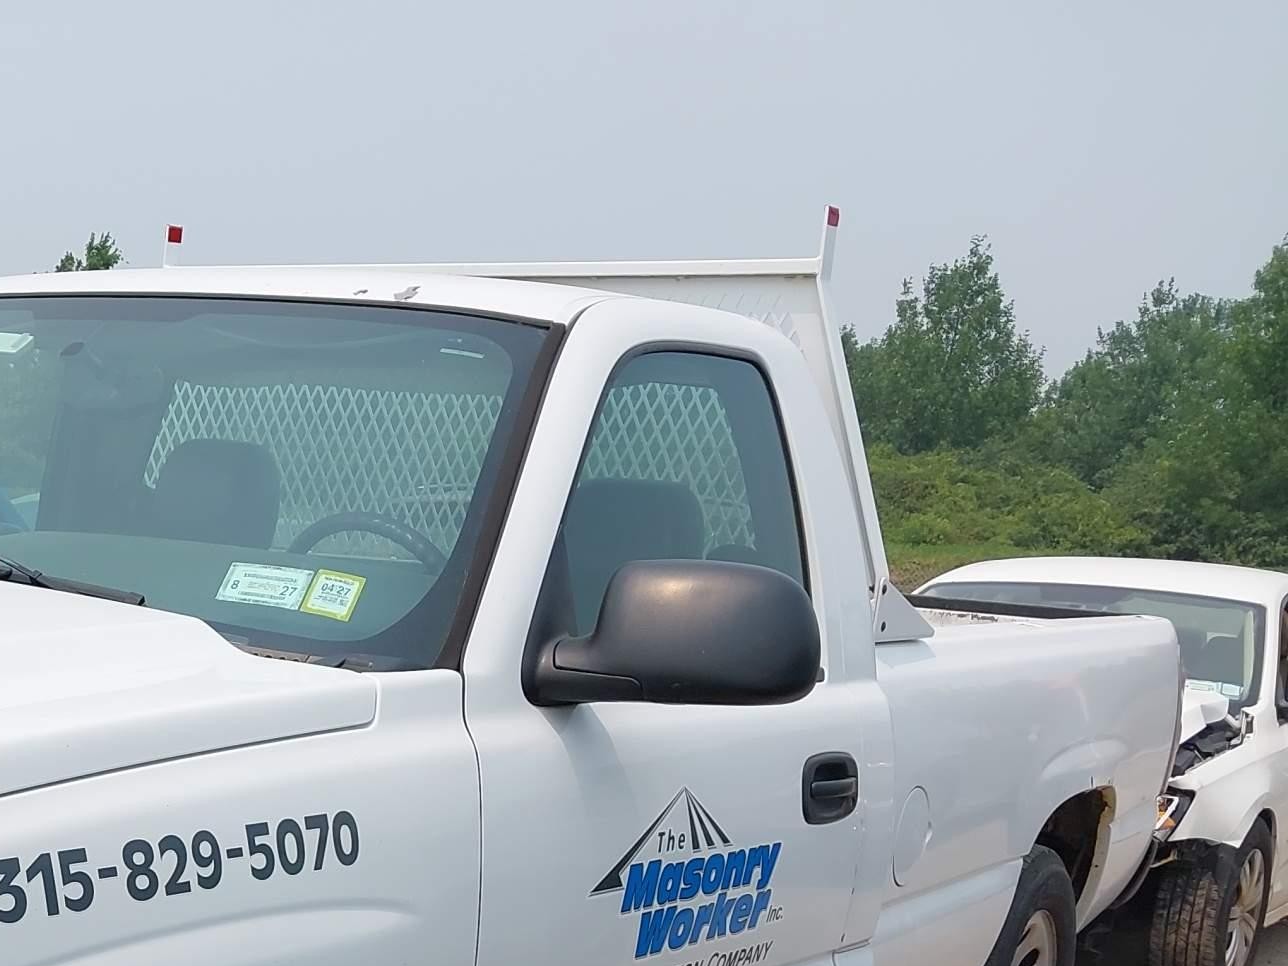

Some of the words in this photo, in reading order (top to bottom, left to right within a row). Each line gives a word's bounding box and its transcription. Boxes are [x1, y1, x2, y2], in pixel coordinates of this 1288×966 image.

[230, 579, 240, 590] 8
[279, 586, 298, 597] 27
[657, 829, 686, 853] The
[620, 842, 782, 913] Masonry
[633, 887, 772, 960] Worker
[766, 905, 783, 923] Inc.
